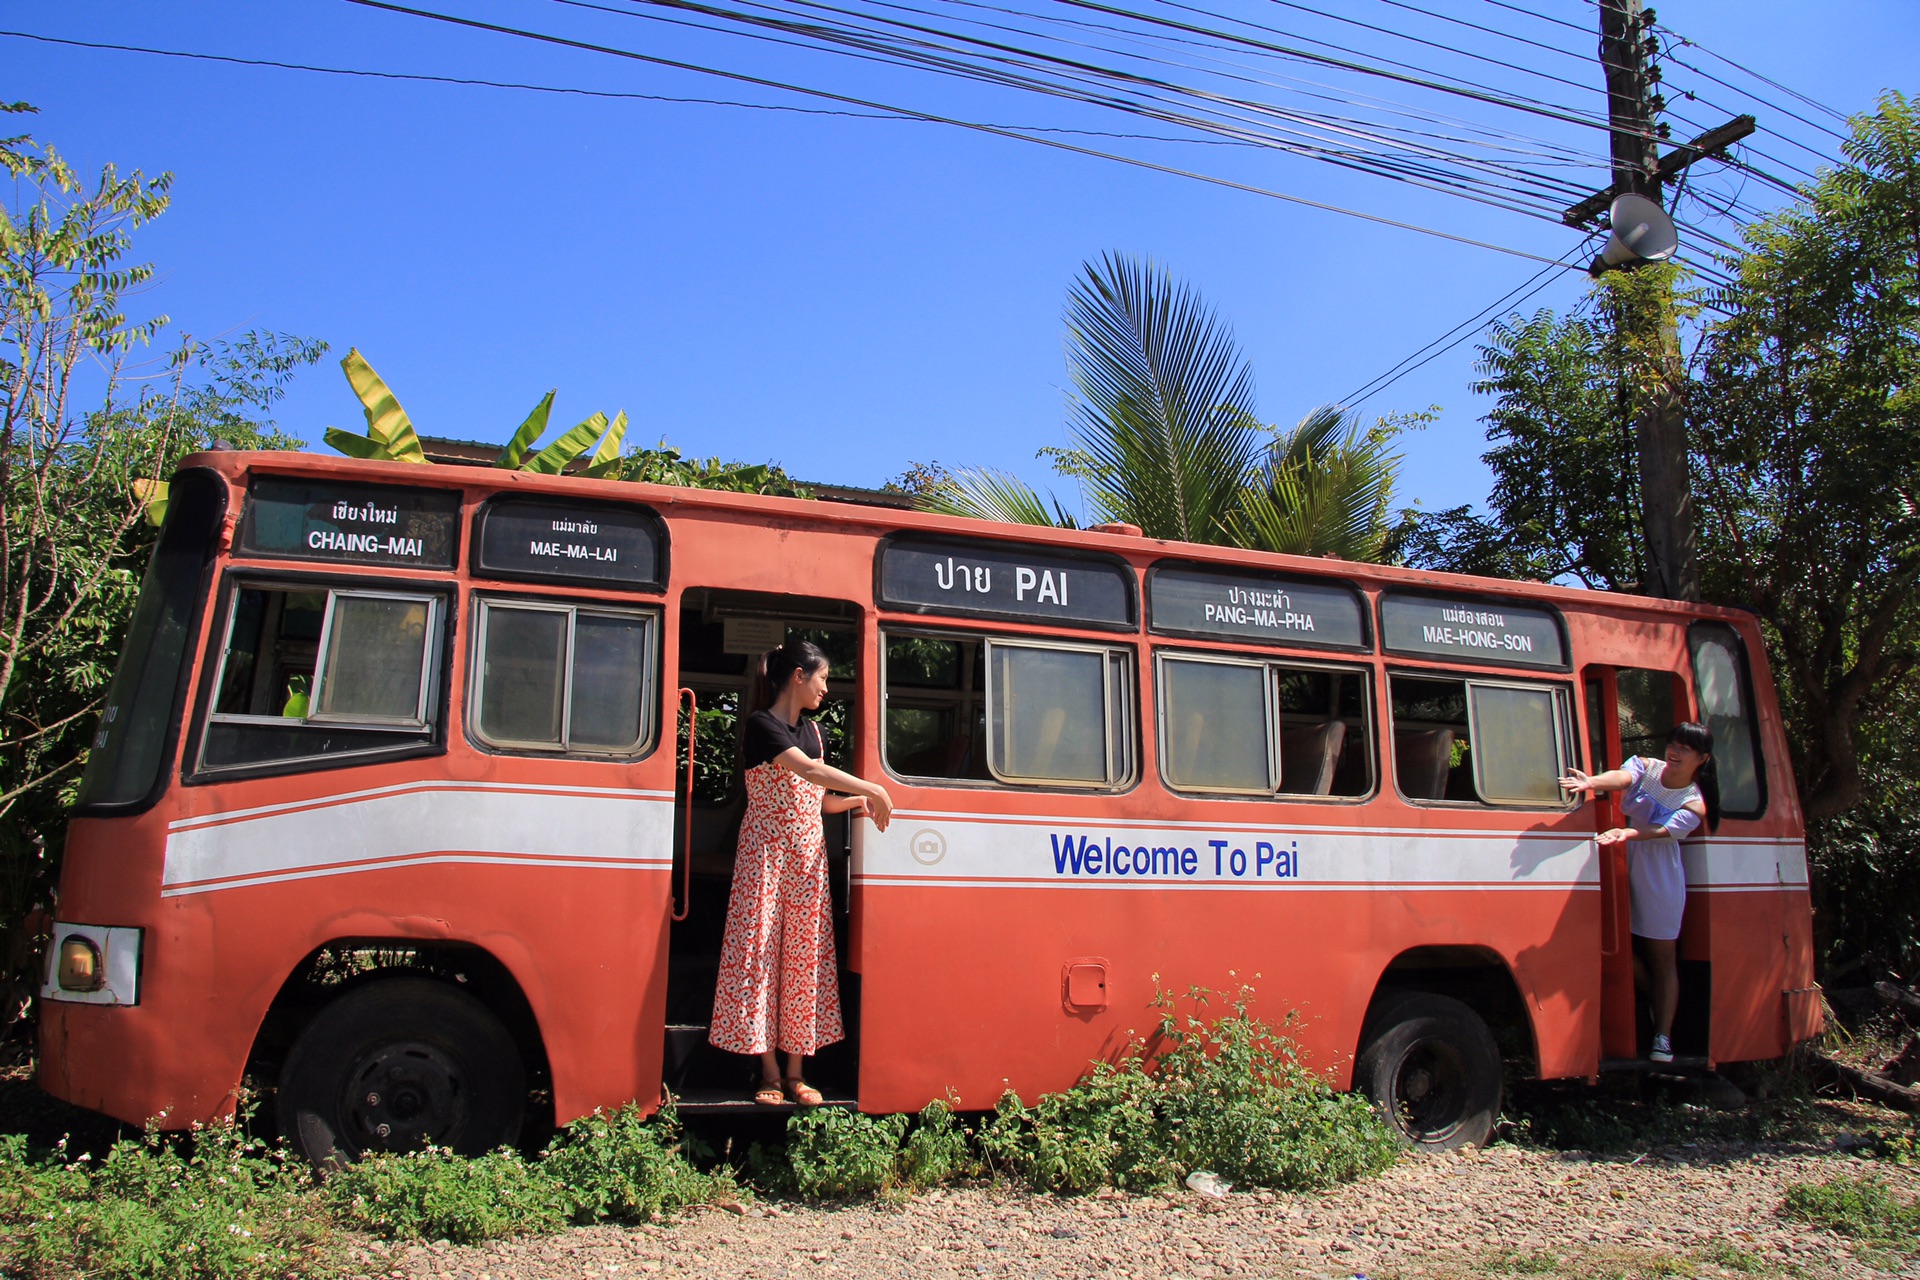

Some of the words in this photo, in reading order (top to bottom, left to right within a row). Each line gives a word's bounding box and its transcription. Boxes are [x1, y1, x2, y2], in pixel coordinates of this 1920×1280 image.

[332, 500, 398, 524] เชียงใหม่
[552, 517, 598, 535] แม่มาลัย
[308, 530, 423, 557] CHAING-MAI
[530, 540, 617, 562] MAE-MA-LAI
[934, 557, 991, 593] ปาย
[1015, 567, 1068, 606] PAI
[1228, 586, 1291, 610] ปางมะผ้า
[1204, 603, 1315, 632] PANG-MA-PHA
[1442, 605, 1504, 627] แม่ฮ่องสอน
[1422, 626, 1532, 652] MAE-HONG-SON
[1050, 833, 1198, 876] Welcome
[1208, 839, 1247, 876] To
[1255, 840, 1299, 878] Pai
